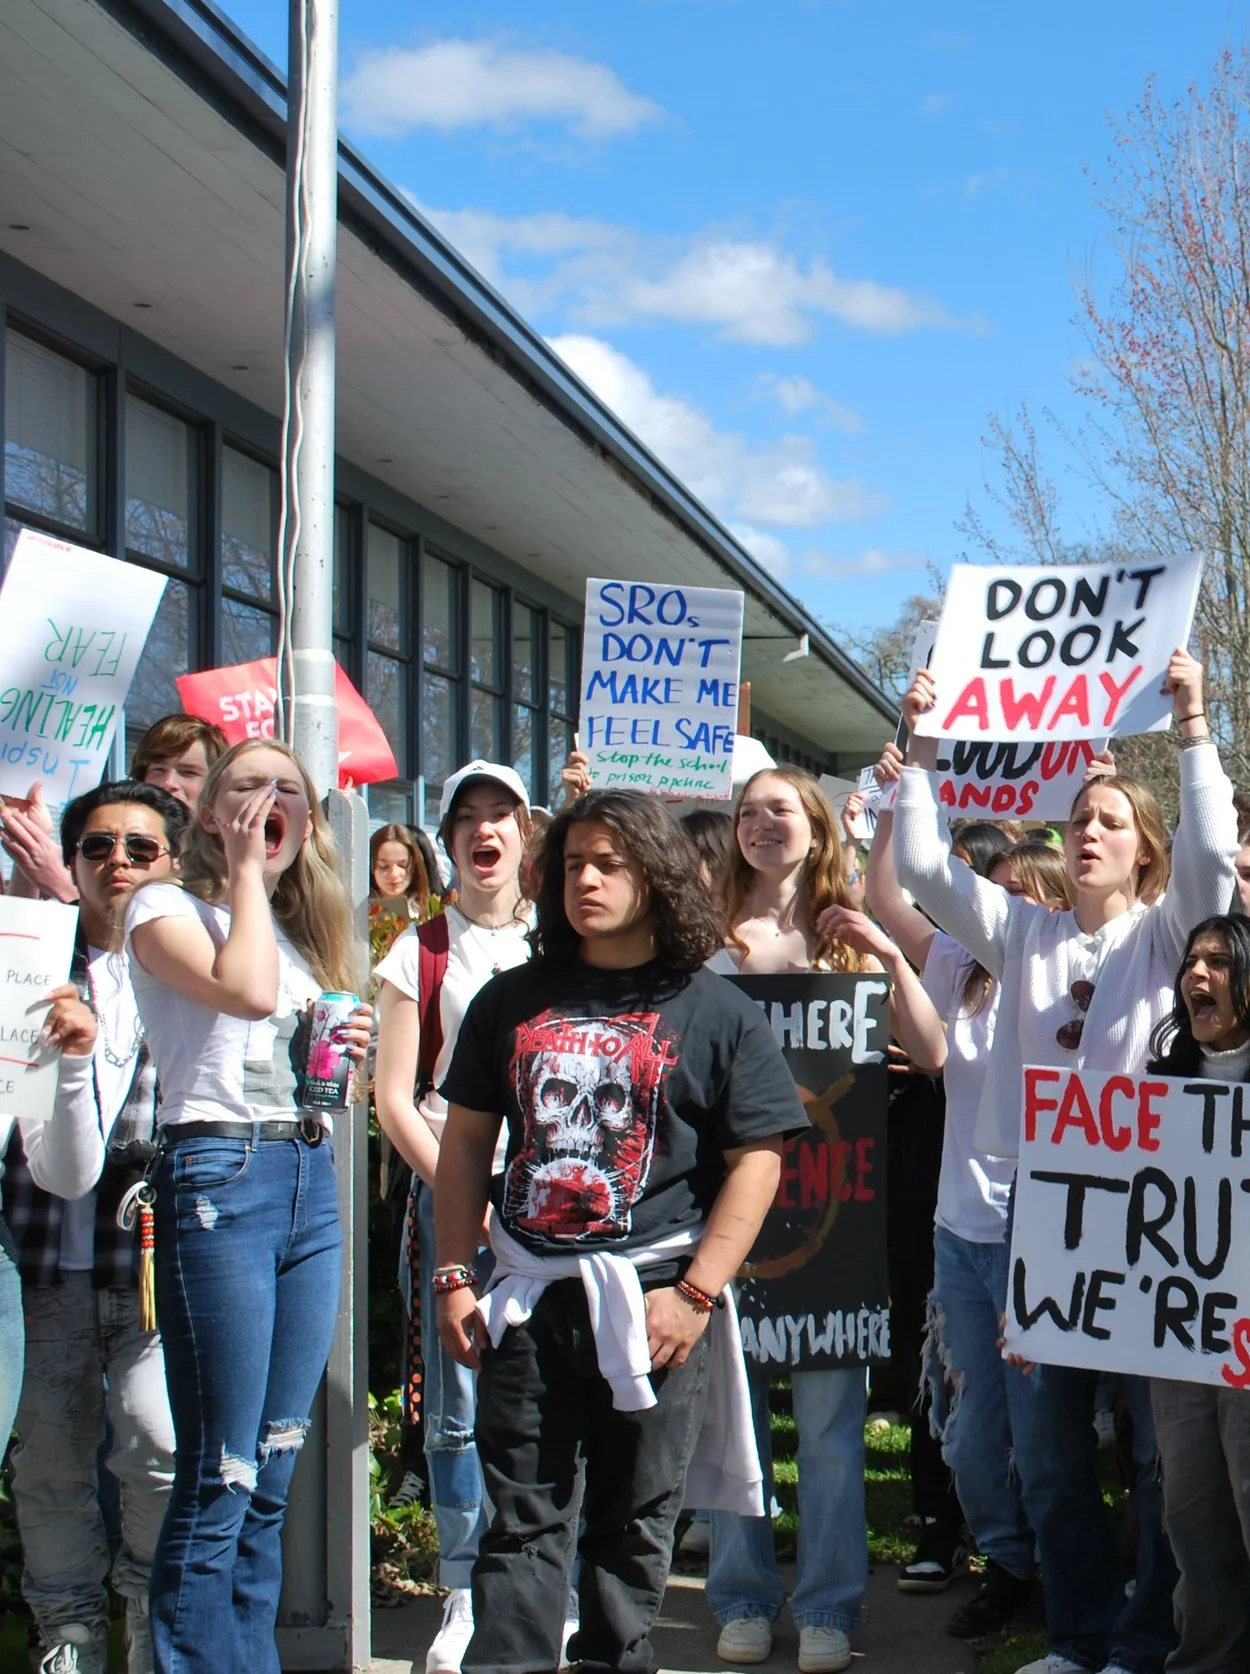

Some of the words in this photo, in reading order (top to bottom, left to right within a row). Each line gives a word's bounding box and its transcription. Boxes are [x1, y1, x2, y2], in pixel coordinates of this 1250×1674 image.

[986, 566, 1166, 621] DON'T
[44, 618, 127, 676] FEAR
[602, 633, 729, 668] DON'T
[980, 616, 1145, 669] LOOK
[41, 669, 78, 696] NOT
[586, 670, 684, 705] MAKE
[697, 679, 736, 707] ME
[941, 664, 1143, 732] AWAY
[0, 688, 116, 750] HEALING
[219, 688, 277, 722] STA
[245, 718, 275, 740] FO
[587, 715, 670, 748] FEEL
[675, 718, 736, 755] SAFE
[0, 741, 91, 809] Inspi
[596, 751, 639, 770] Stop
[642, 752, 672, 768] the
[606, 772, 652, 790] prison
[938, 779, 1039, 815] ANDS
[6, 969, 53, 987] PLACE
[0, 1025, 40, 1044] LACE
[515, 1023, 588, 1054] DEATH
[758, 981, 887, 1064] HERE
[1024, 1068, 1169, 1152] FACE
[778, 1137, 876, 1210] ENCE
[1013, 1257, 1238, 1355] WE'RE
[741, 1309, 892, 1366] ANYWHERE
